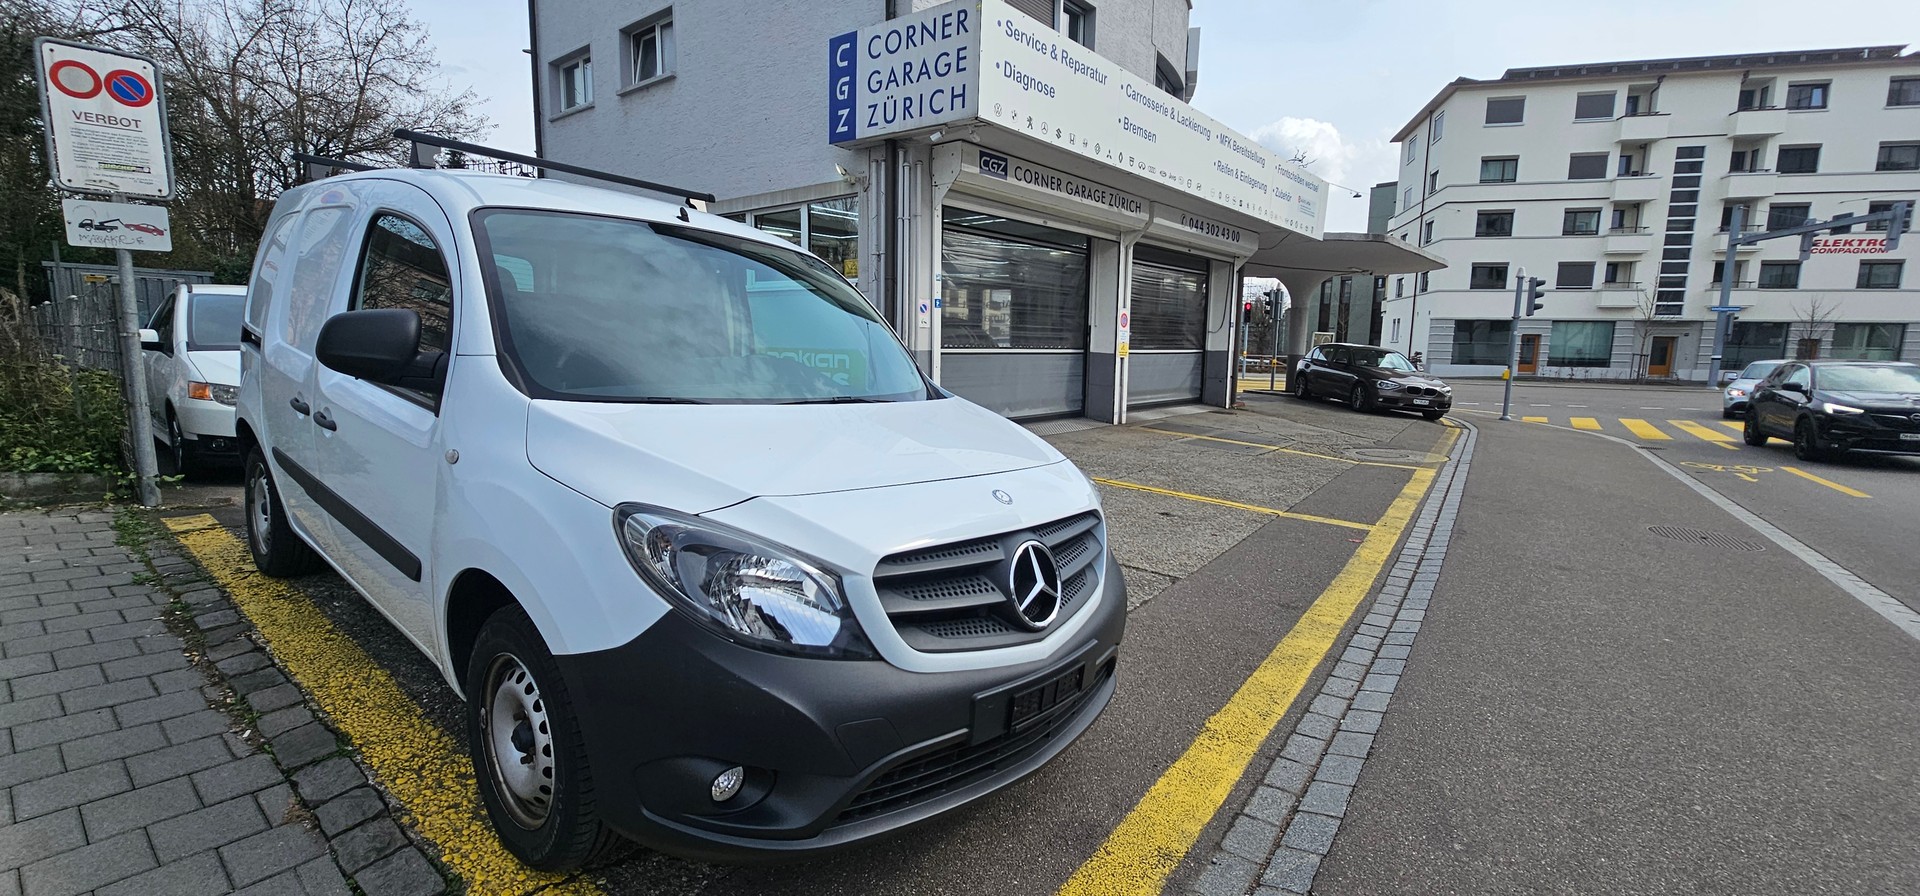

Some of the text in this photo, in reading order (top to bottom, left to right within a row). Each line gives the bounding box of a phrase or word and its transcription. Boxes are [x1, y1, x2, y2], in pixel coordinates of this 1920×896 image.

[868, 9, 969, 59] CORNER
[1005, 20, 1108, 86] Service & Reparatur
[836, 43, 850, 133] CGZ
[868, 46, 968, 94] GARAGE
[1004, 60, 1056, 98] Diagnose
[72, 110, 142, 128] VERBOT
[867, 84, 966, 128] ZÜRICH
[1125, 83, 1211, 141] Carrosserie & Lackierung
[1123, 117, 1157, 143] Bremsen
[980, 155, 1006, 176] CGZ
[1220, 133, 1266, 168] MFK Bereitstellung
[1014, 166, 1142, 214] CORNER GARAGE ZÜRICH
[1217, 161, 1268, 194] Reifen & Einlagerung
[1189, 216, 1241, 243] 044 302 43 00
[1812, 239, 1887, 247] ELEKTRO
